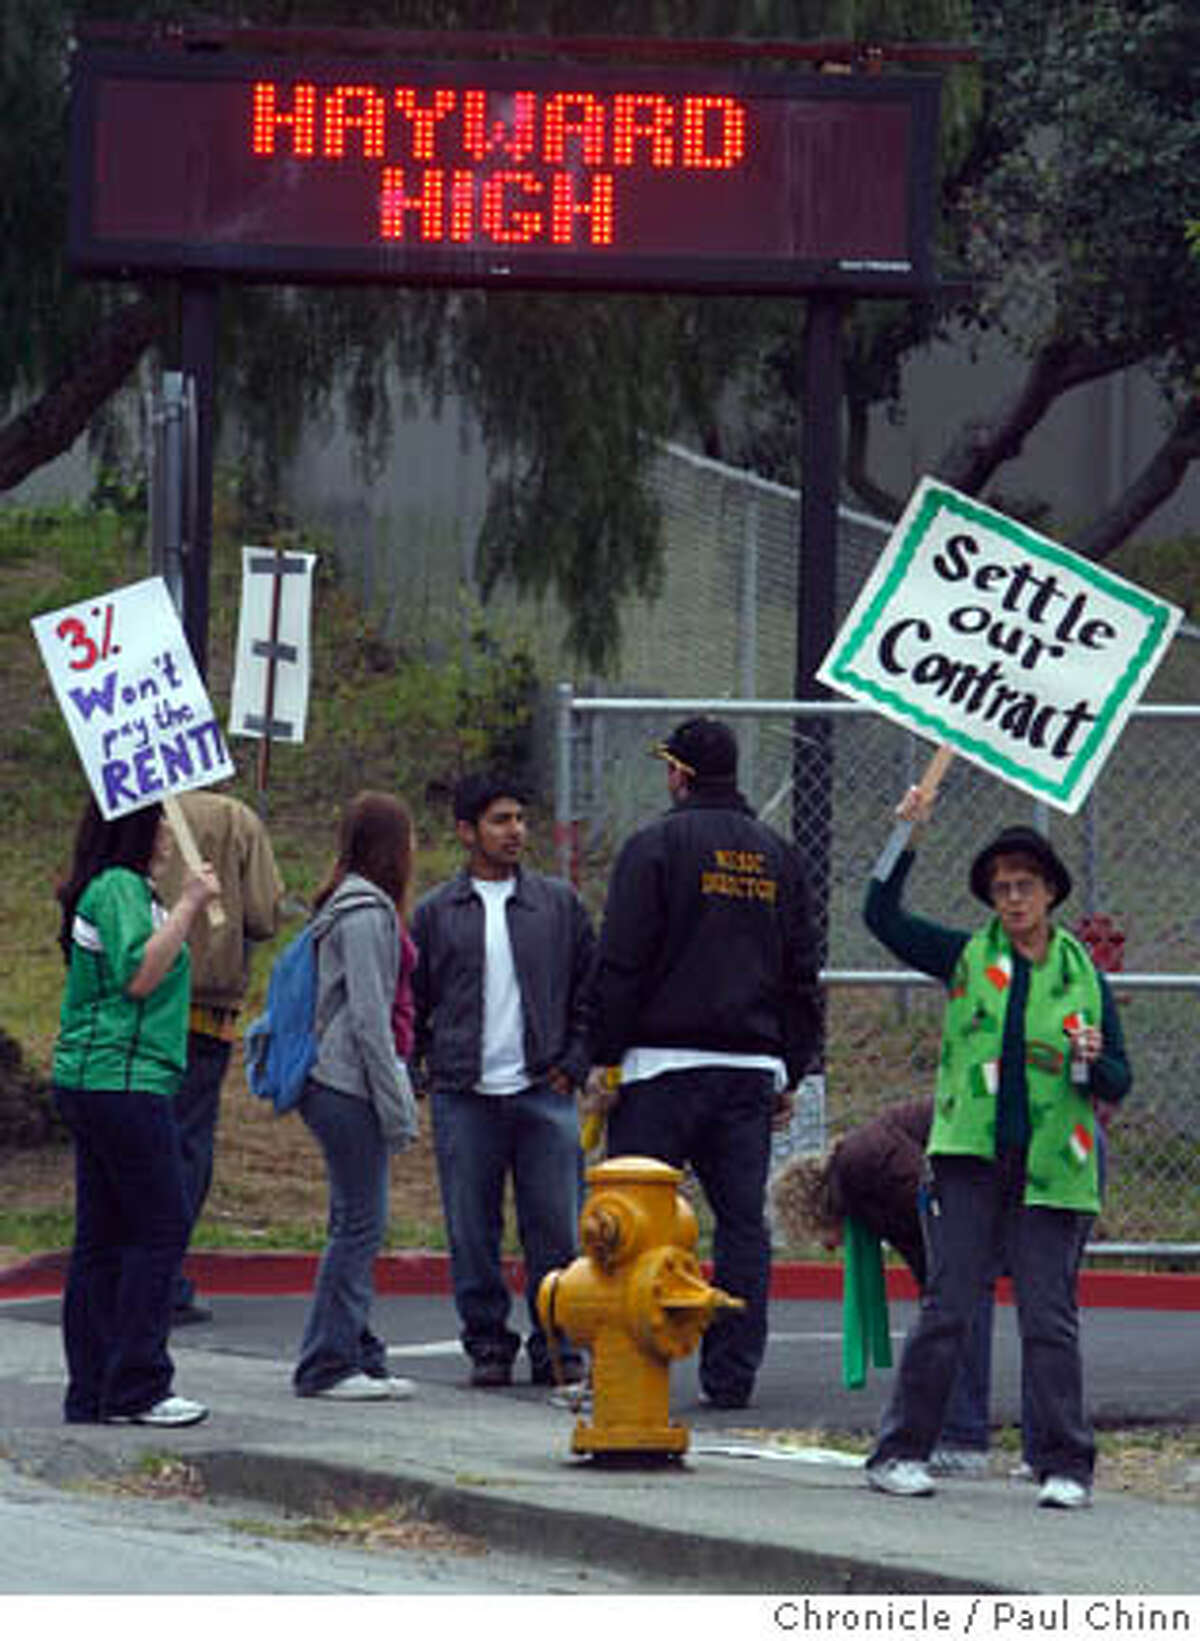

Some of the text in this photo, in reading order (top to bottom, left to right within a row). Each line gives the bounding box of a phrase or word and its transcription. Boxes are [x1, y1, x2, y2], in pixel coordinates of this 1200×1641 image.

[250, 82, 745, 168] HAYWARD
[380, 167, 614, 244] HIGH
[933, 533, 1118, 650] Settle
[55, 603, 121, 671] 3%
[949, 606, 1064, 670] our
[67, 651, 183, 723] Won't
[153, 697, 195, 732] the
[878, 617, 1099, 759] Contract
[102, 721, 226, 810] RENT!
